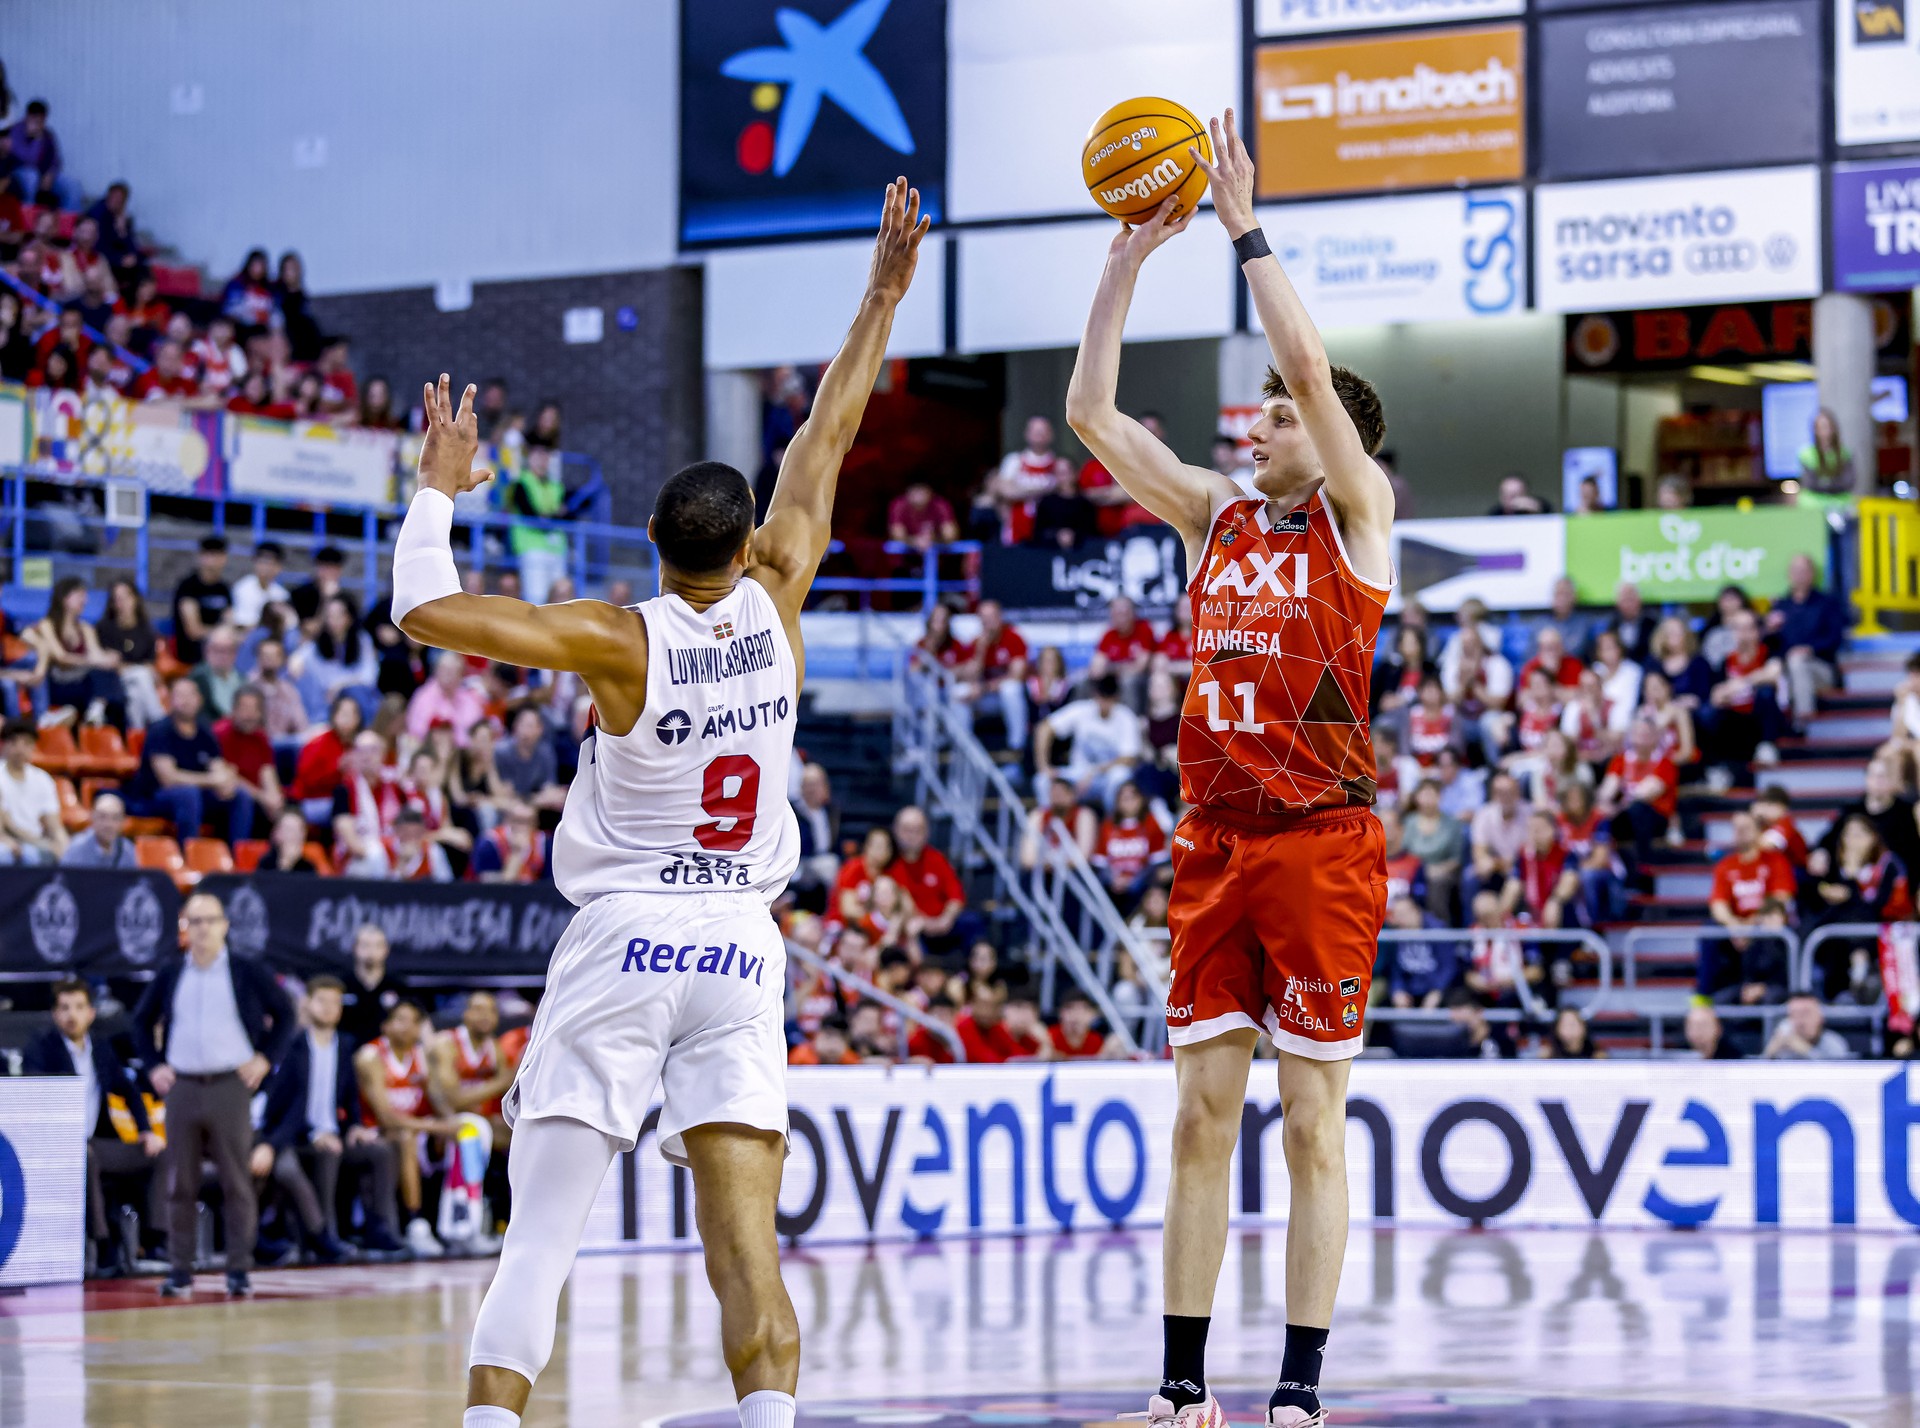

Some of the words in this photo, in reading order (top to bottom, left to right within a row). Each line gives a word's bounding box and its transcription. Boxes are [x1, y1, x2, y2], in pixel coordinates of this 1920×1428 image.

[1337, 57, 1516, 115] innaltech
[1089, 135, 1130, 167] endesa
[1131, 127, 1158, 141] liga
[1100, 158, 1183, 204] Wilson
[1556, 204, 1735, 245] movento
[1464, 190, 1515, 313] CSJ
[1557, 248, 1671, 281] sarsa
[1633, 304, 1812, 360] BAR
[1620, 544, 1692, 582] brot
[701, 695, 788, 739] AMUTIO
[1198, 680, 1265, 735] 11
[692, 754, 760, 852] 9
[621, 937, 765, 987] Recalvi
[1342, 984, 1355, 995] acb
